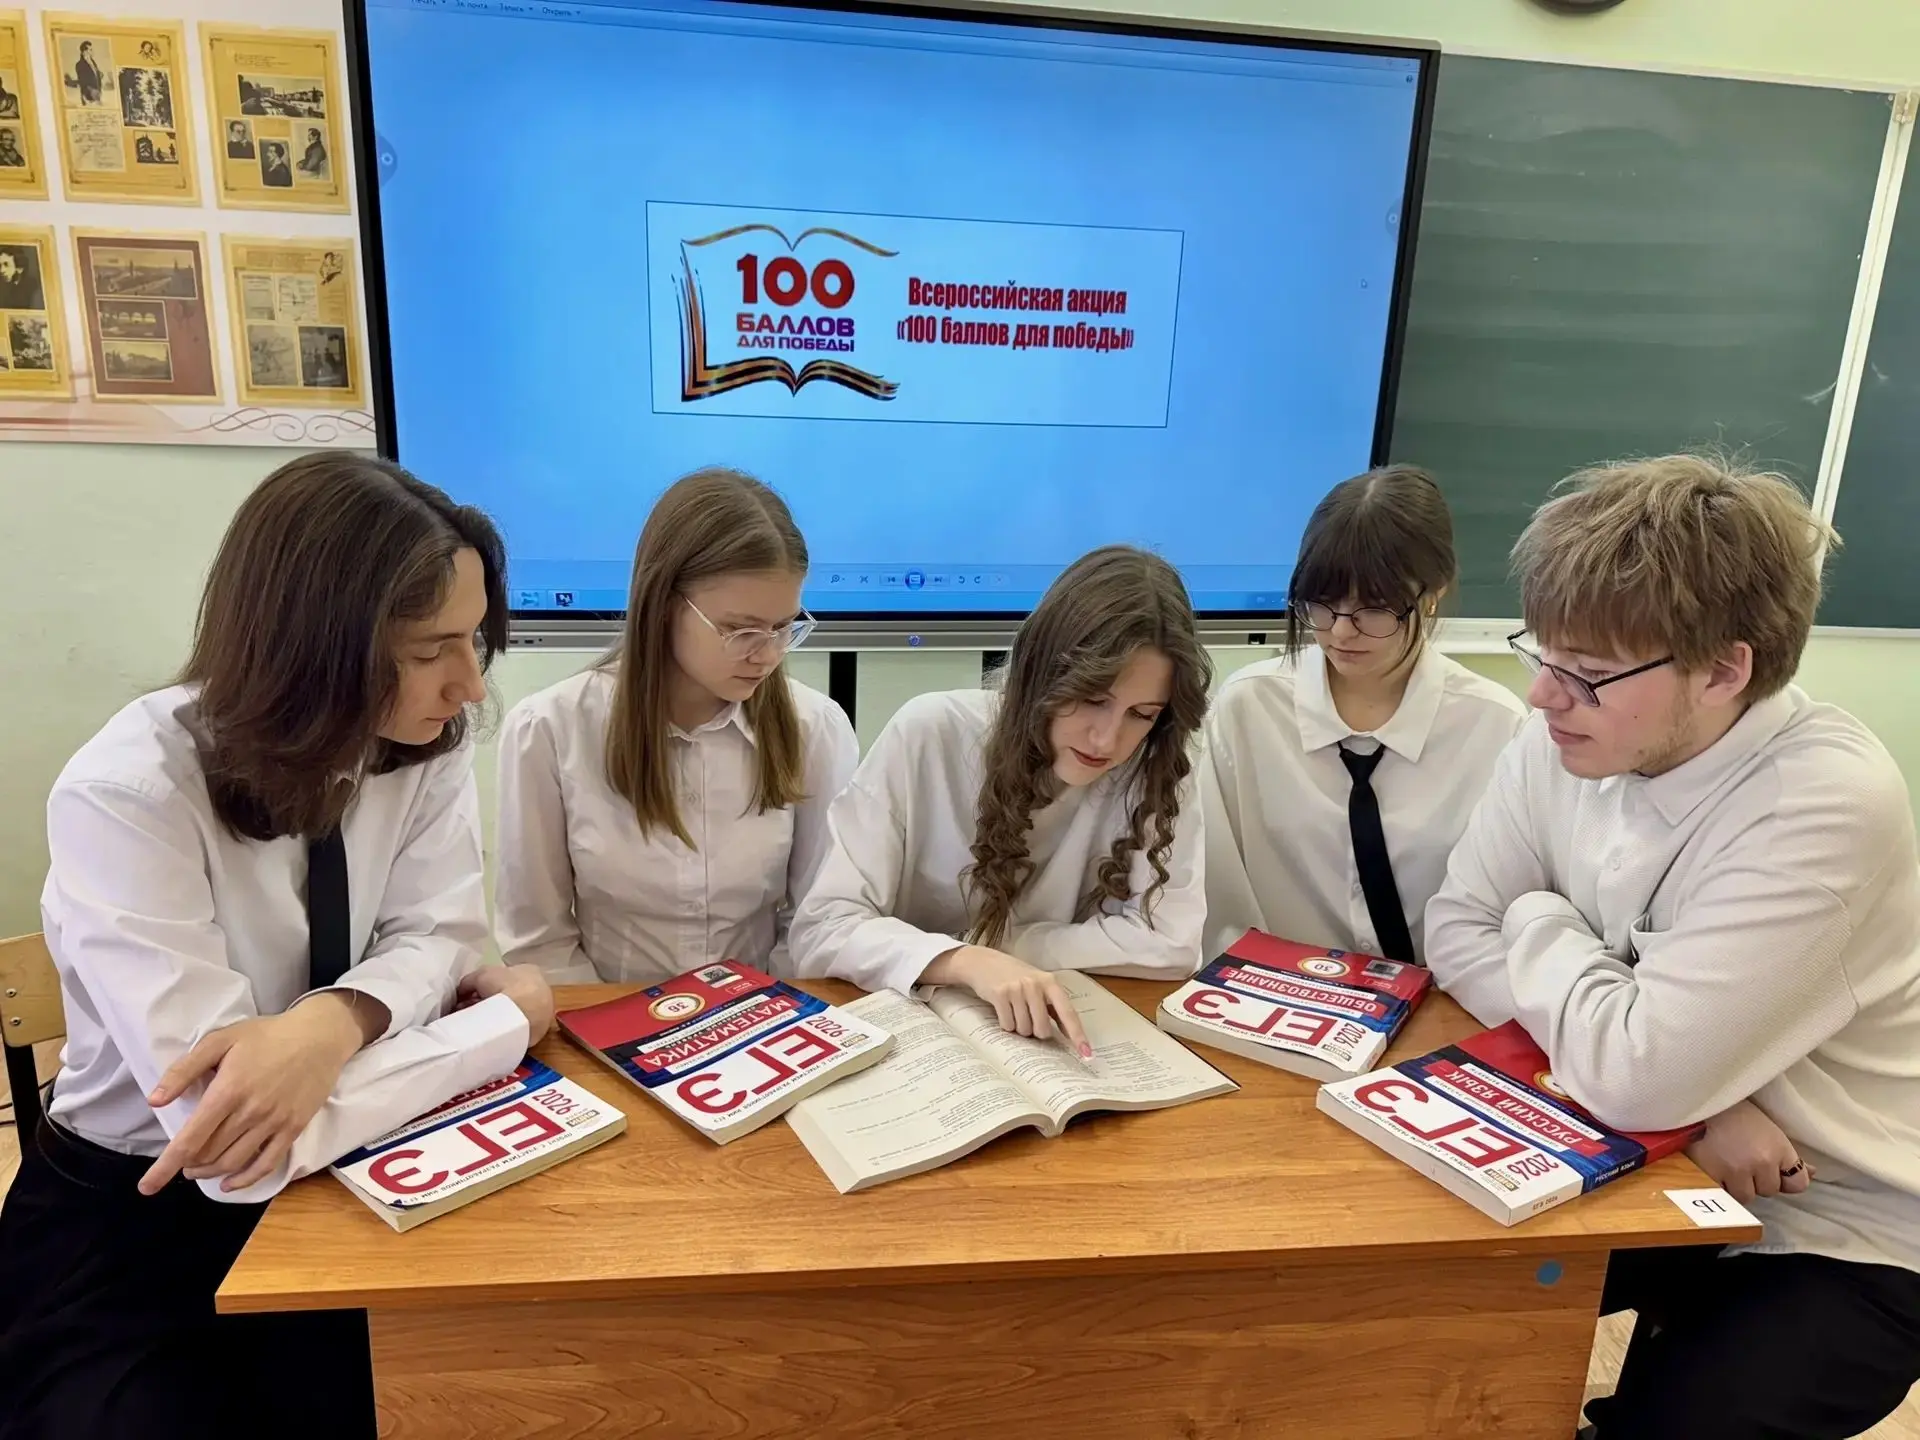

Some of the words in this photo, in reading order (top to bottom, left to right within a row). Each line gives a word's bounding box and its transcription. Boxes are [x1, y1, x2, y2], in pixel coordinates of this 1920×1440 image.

[736, 252, 855, 308] 100
[908, 276, 1063, 311] Всероссийская
[1067, 286, 1127, 317] акция
[736, 313, 855, 336] БАЛЛОВ
[941, 318, 1008, 346] баллов
[1012, 324, 1049, 349] для
[736, 335, 775, 349] ДЛЯ
[779, 336, 855, 352] ПОБЕДЫ
[668, 1003, 687, 1012] 36
[1226, 969, 1378, 1013] ОБЩЕСТВОЗНАНИЕ
[643, 999, 793, 1066] МАТЕМАТИКА
[806, 1015, 842, 1038] 2026
[1182, 989, 1338, 1046] ЕГЭ
[1334, 1023, 1366, 1049] 2026
[676, 1026, 842, 1114] ЕГЭ
[1445, 1070, 1499, 1099] ЯЗЫК
[532, 1089, 575, 1116] 2026
[1496, 1097, 1583, 1144] РУССКИЙ
[1354, 1079, 1530, 1168] ЕГЭ
[367, 1101, 566, 1194] ЕГЭ
[1507, 1153, 1559, 1180] 2026
